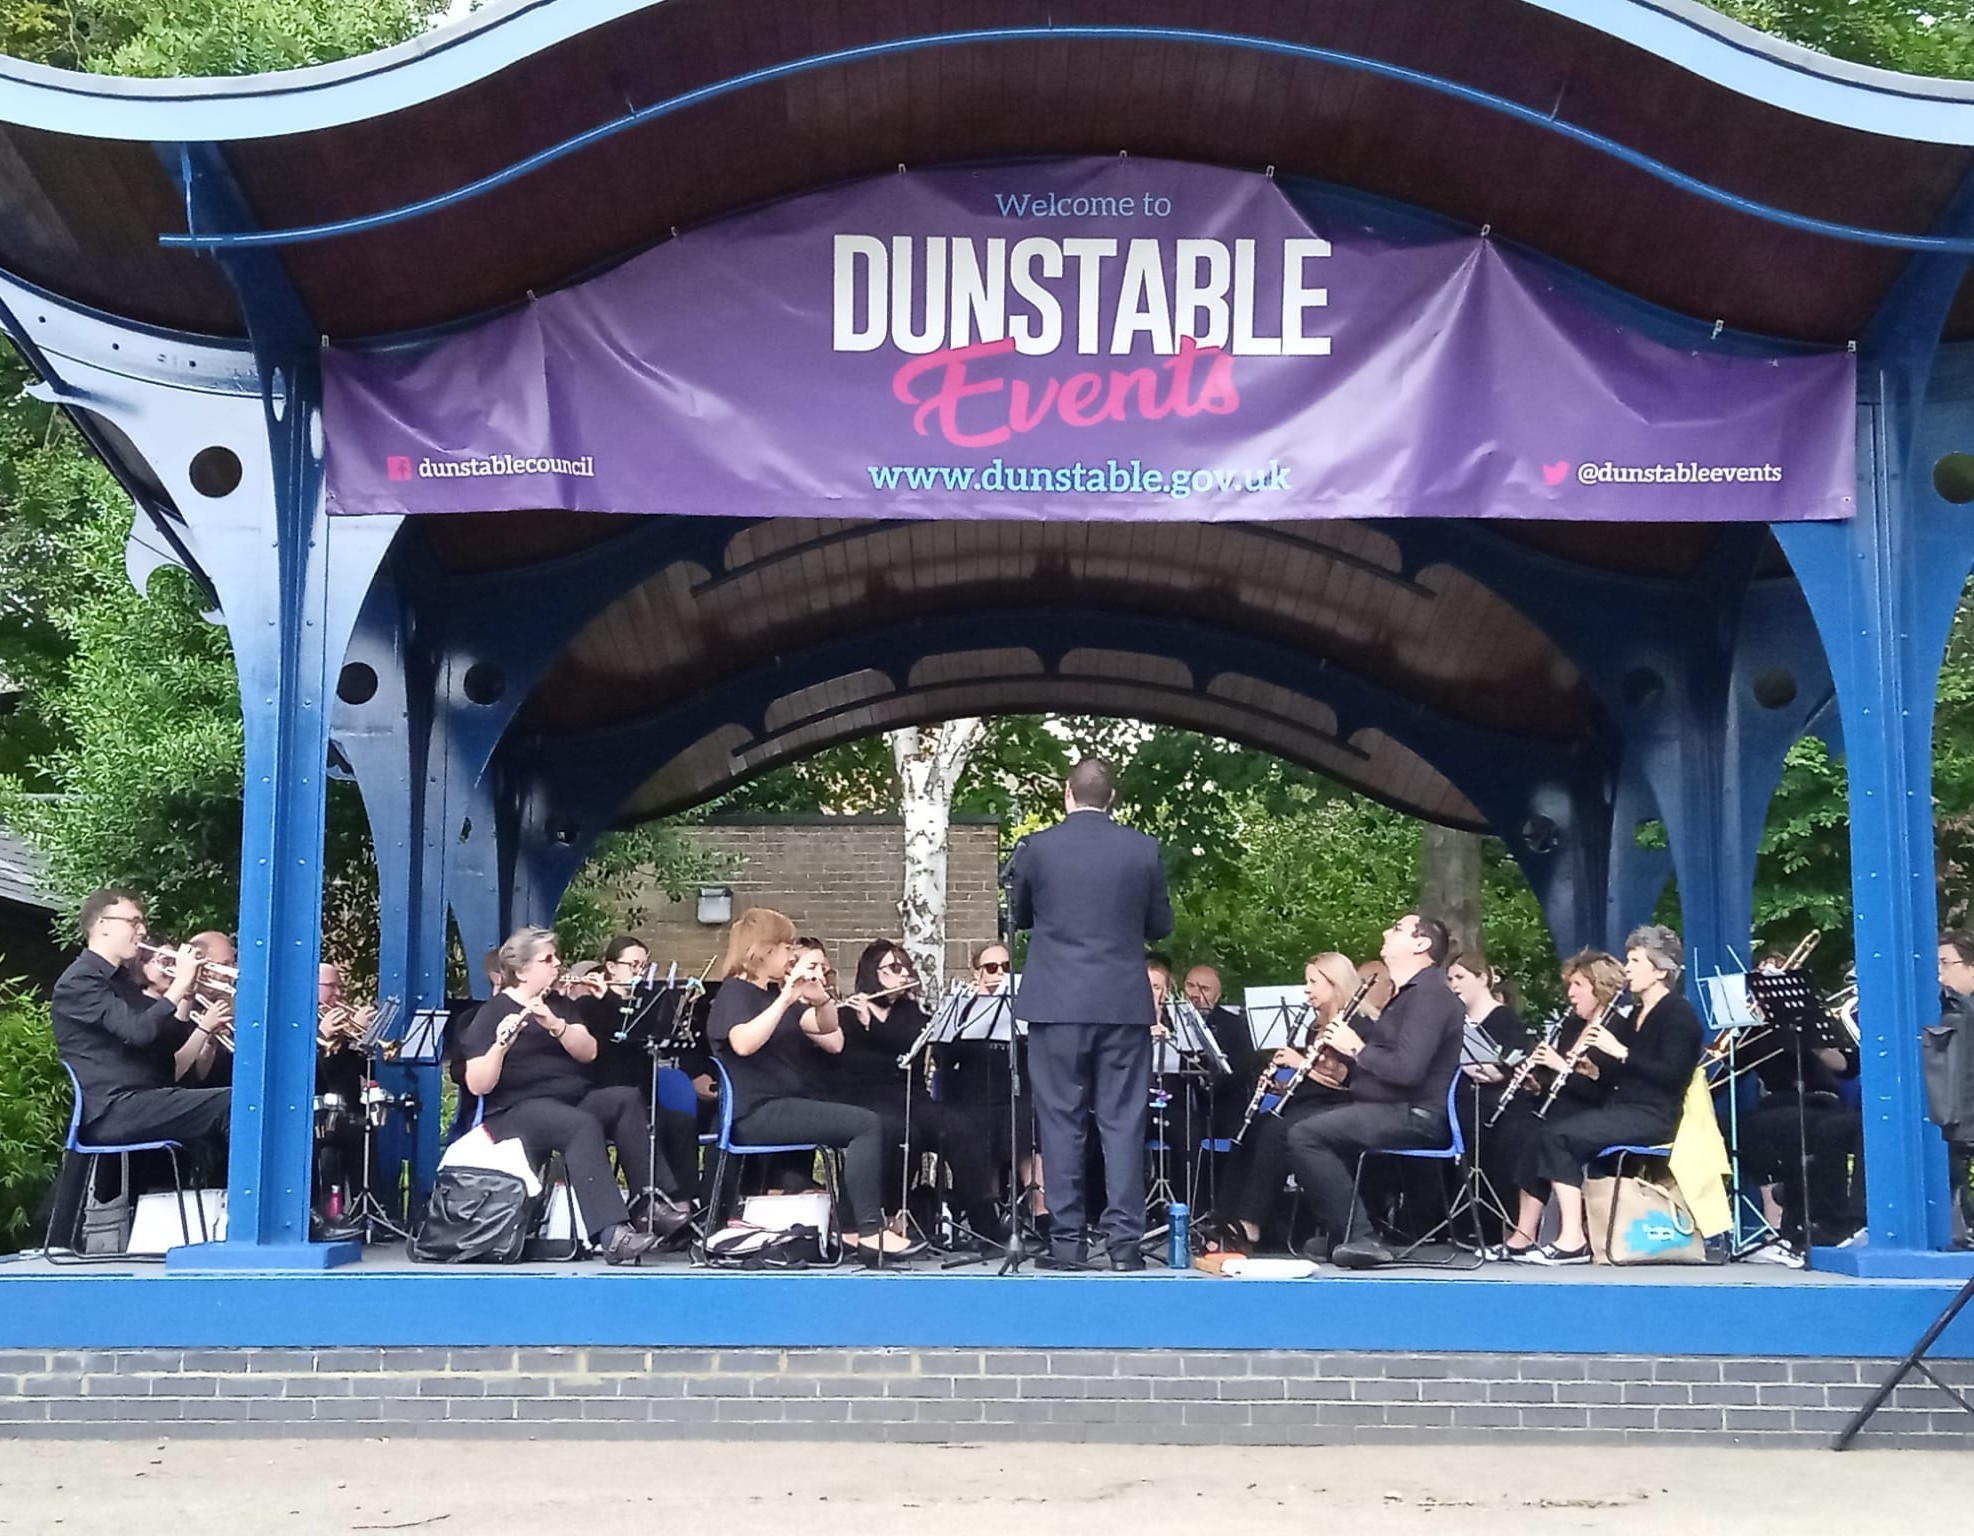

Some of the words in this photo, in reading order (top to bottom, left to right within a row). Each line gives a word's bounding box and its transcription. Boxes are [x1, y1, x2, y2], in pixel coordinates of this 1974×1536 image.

[995, 192, 1134, 217] Welcome
[1143, 192, 1172, 217] to
[832, 233, 1332, 356] DUNSTABLE
[892, 334, 1240, 448] Events
[418, 455, 595, 477] dunstablecouncil
[867, 458, 1292, 498] www.dunstable.gov.uk
[1577, 462, 1783, 485] @dunstableevents
